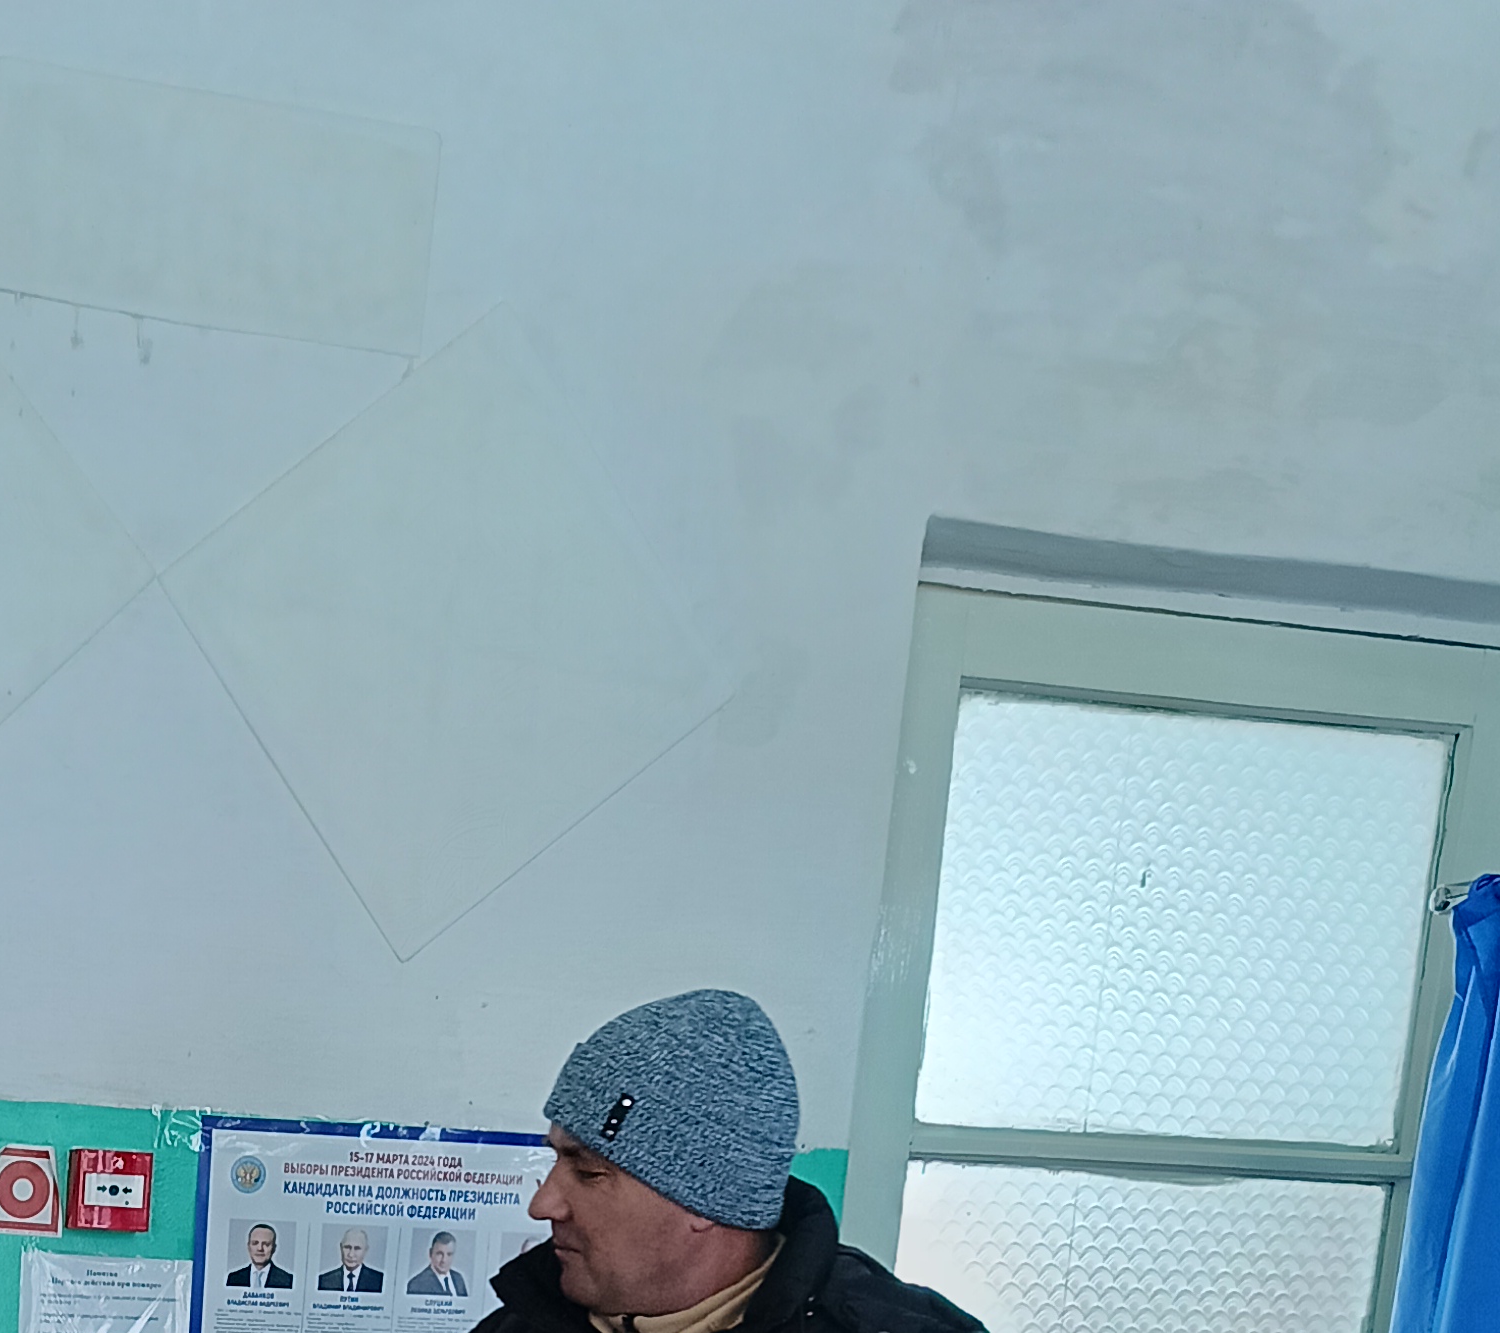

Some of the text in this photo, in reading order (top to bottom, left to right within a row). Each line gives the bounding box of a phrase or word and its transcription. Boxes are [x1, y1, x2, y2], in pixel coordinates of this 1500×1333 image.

[349, 1152, 462, 1169] 15-17 МАРТА 2024 ГОДА
[284, 1162, 523, 1186] ВЫБОРЫ ПРЕЗИДЕНТА РОССИЙСКОЙ ФЕДЕРАЦИИ
[283, 1181, 520, 1205] КАНДИДАТЫ НА ДОЛЖНОСТЬ ПРЕЗИДЕНТА
[326, 1200, 476, 1220] РОССИЙСКОЙ ФЕДЕРАЦИИ
